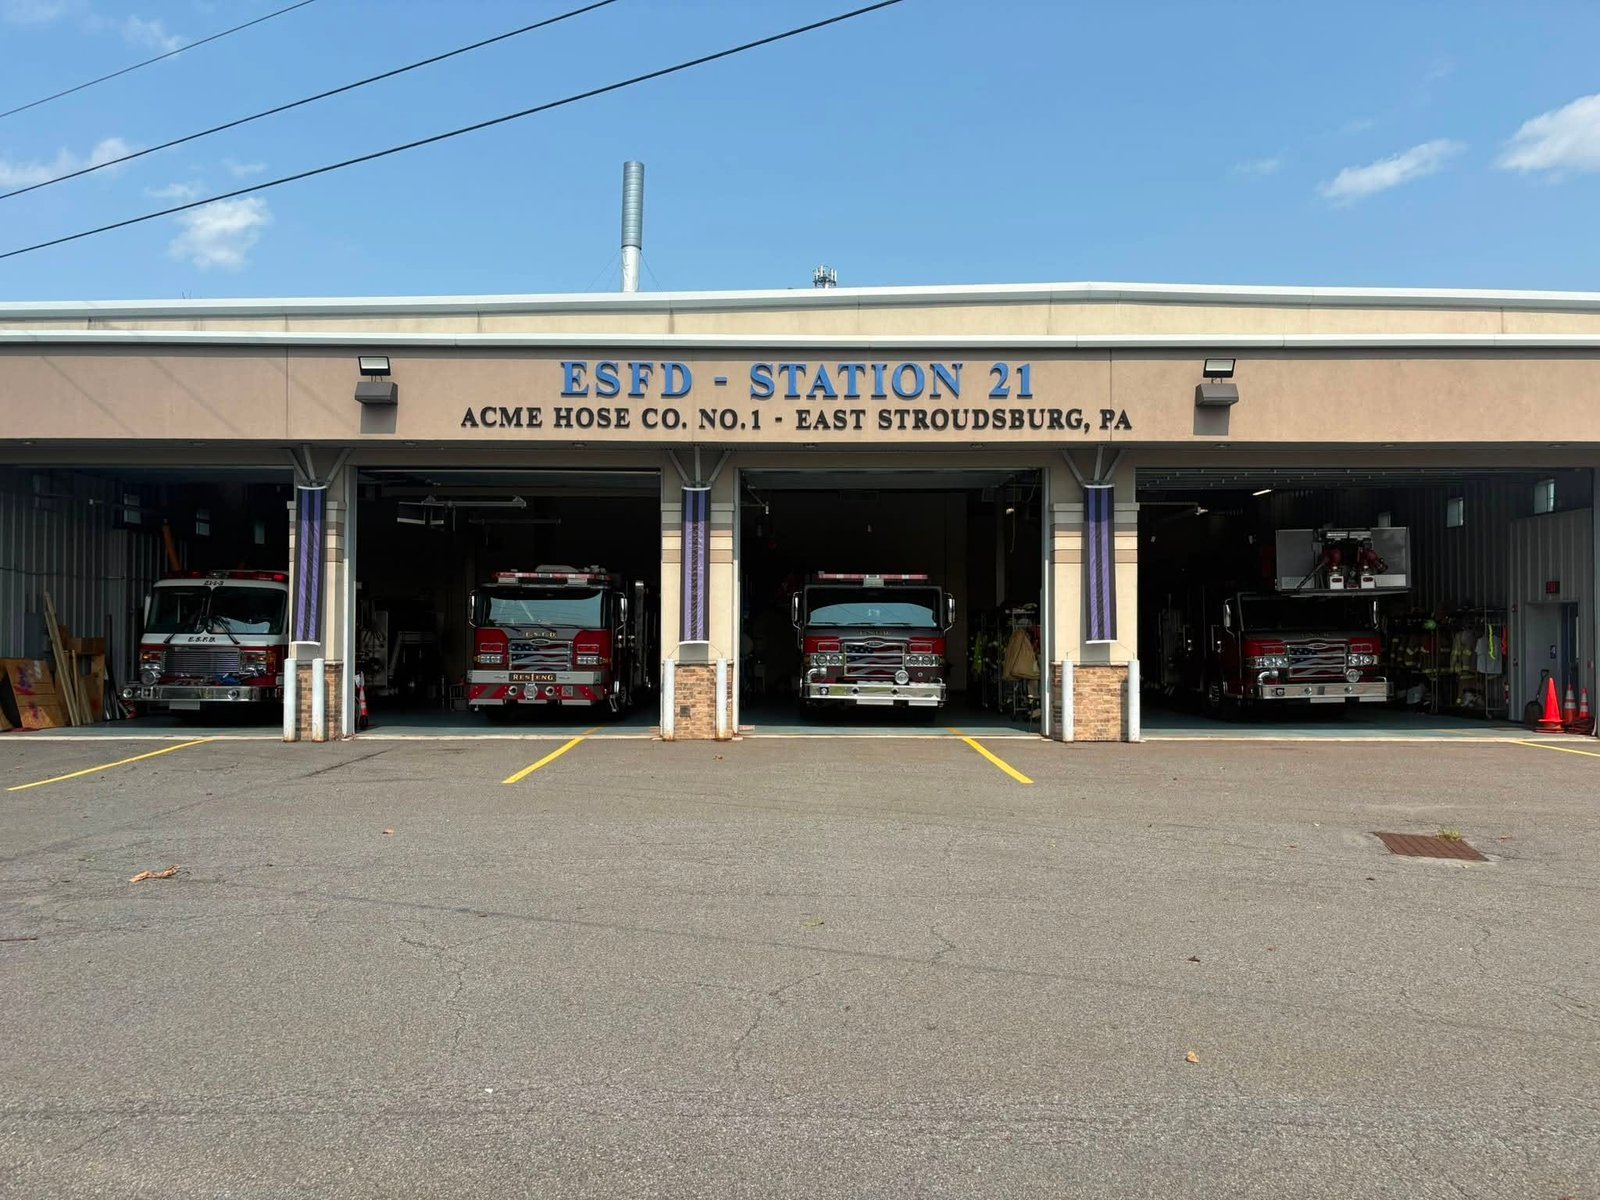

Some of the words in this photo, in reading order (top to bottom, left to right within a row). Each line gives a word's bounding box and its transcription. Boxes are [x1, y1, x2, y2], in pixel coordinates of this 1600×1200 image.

[561, 361, 692, 398] ESFD
[714, 377, 727, 385] -
[750, 362, 962, 399] STATION
[989, 362, 1033, 398] 21
[461, 407, 542, 428] ACME
[554, 408, 630, 428] HOSE
[642, 408, 686, 429] CO.
[699, 409, 760, 430] NO.1
[796, 410, 865, 430] EAST
[879, 409, 1090, 433] STROUDSBURG,
[1100, 409, 1132, 430] PA
